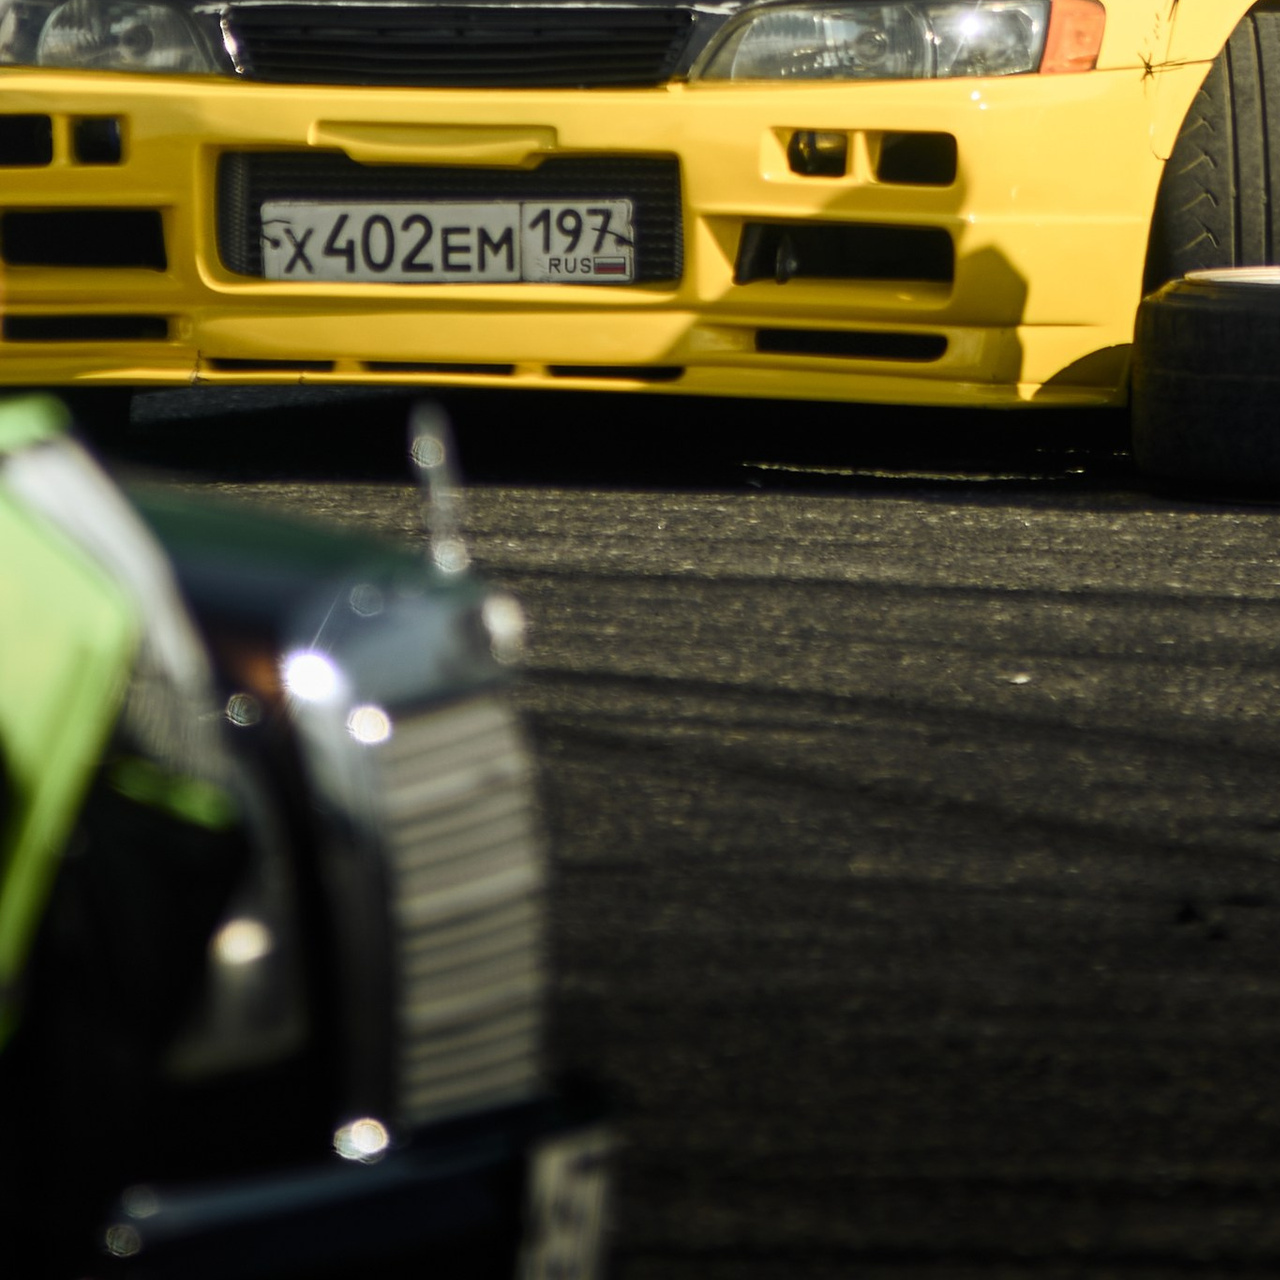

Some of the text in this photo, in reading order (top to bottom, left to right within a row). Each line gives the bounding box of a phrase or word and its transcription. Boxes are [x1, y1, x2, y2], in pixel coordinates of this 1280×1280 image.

[284, 213, 515, 274] Х402ЕМ
[528, 209, 613, 255] 197
[548, 258, 592, 274] RUS
